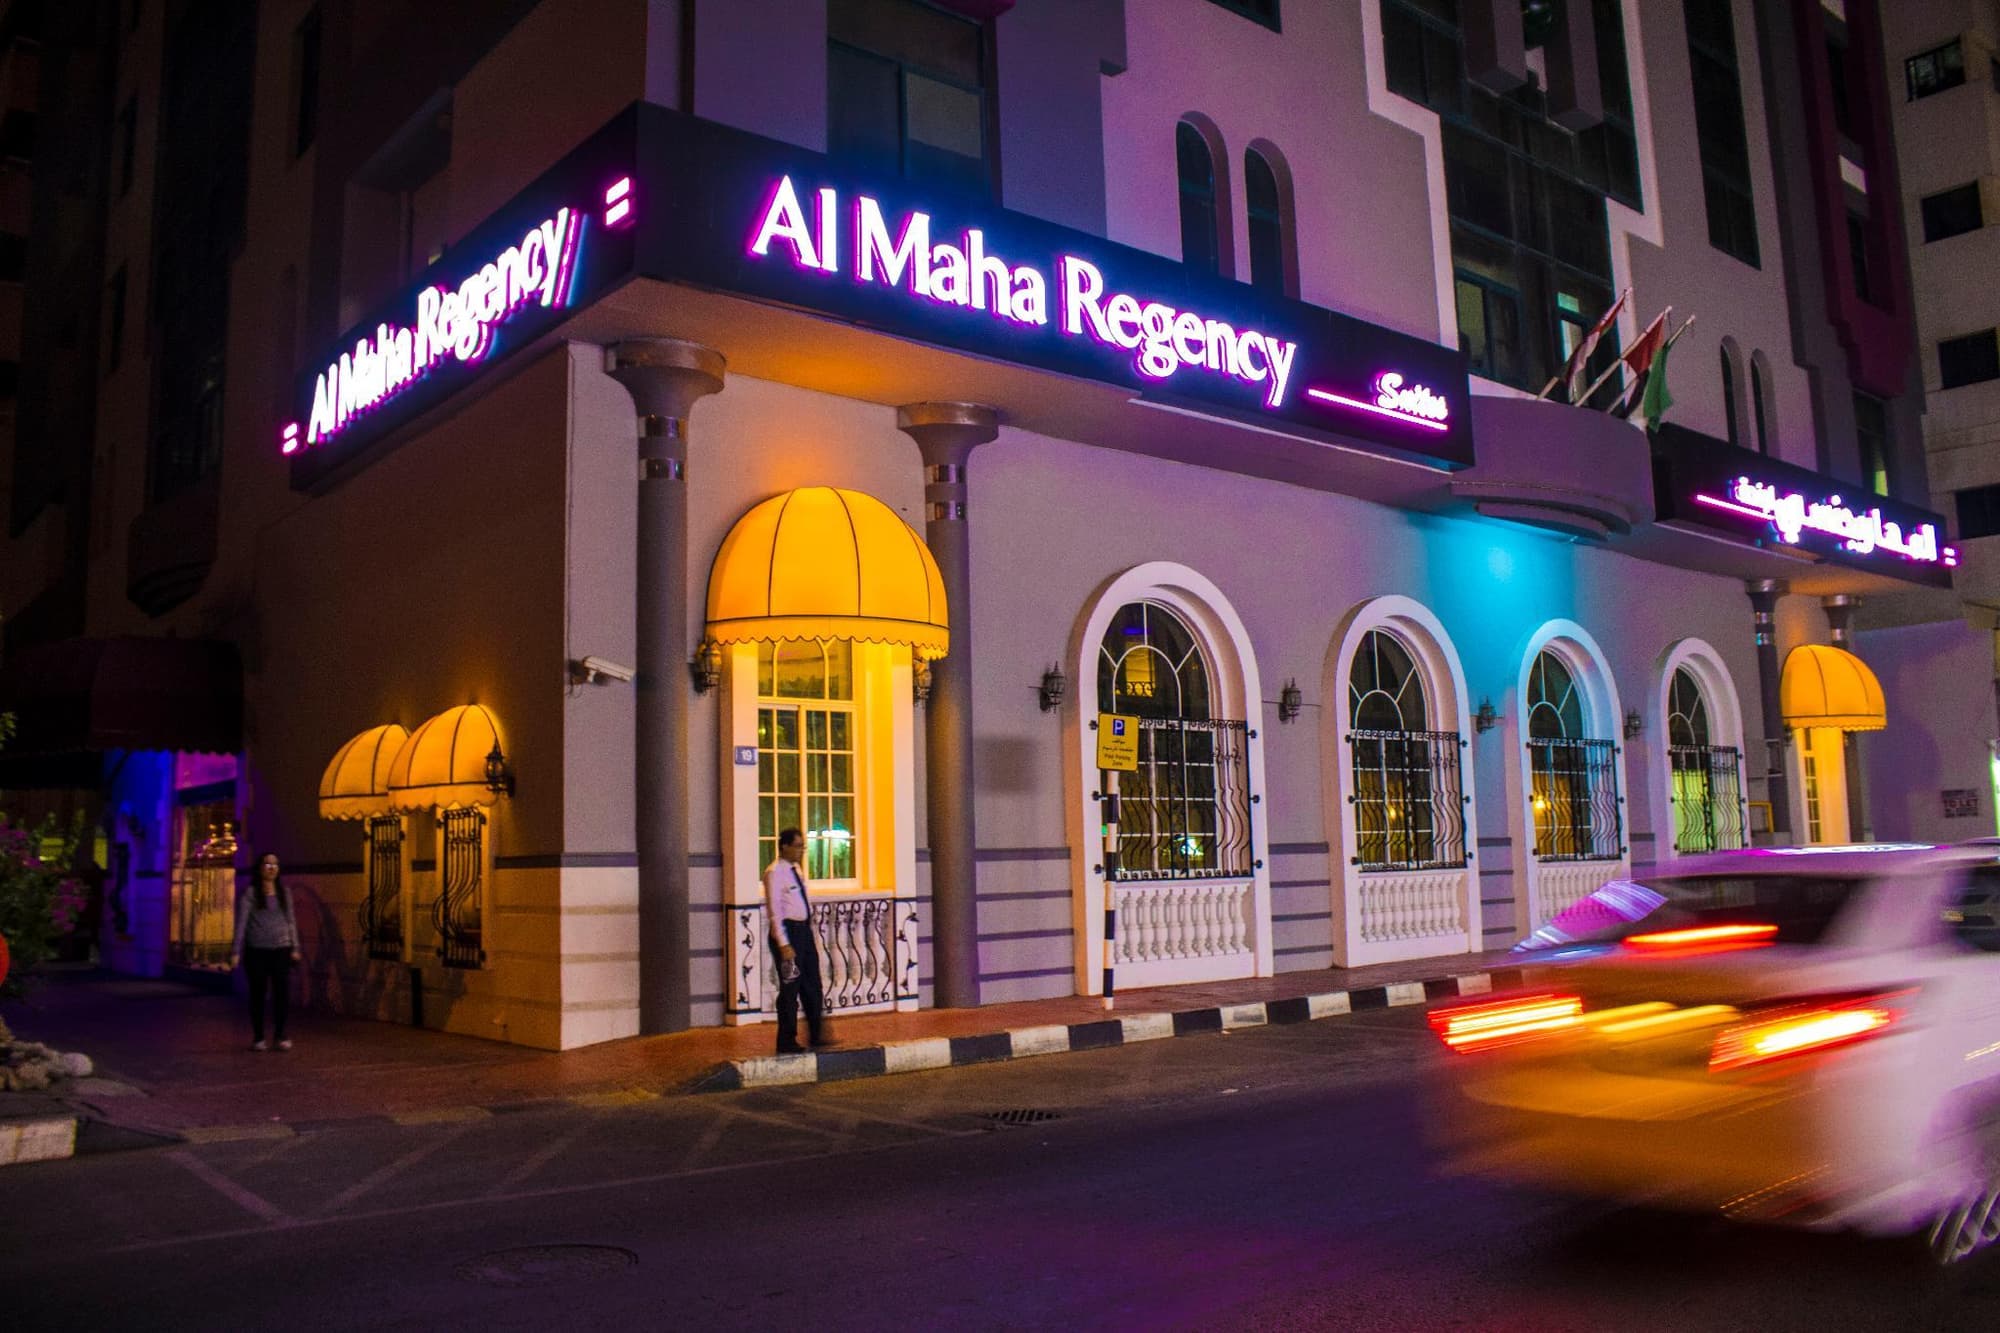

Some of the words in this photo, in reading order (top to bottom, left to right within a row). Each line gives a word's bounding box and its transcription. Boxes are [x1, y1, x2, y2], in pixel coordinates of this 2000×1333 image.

[306, 363, 338, 444] Al
[338, 323, 413, 426] Maha
[414, 207, 570, 372] Regency
[751, 174, 838, 271] Al
[856, 195, 1047, 326] Maha
[1061, 254, 1297, 407] Regency
[1114, 719, 1124, 736] P
